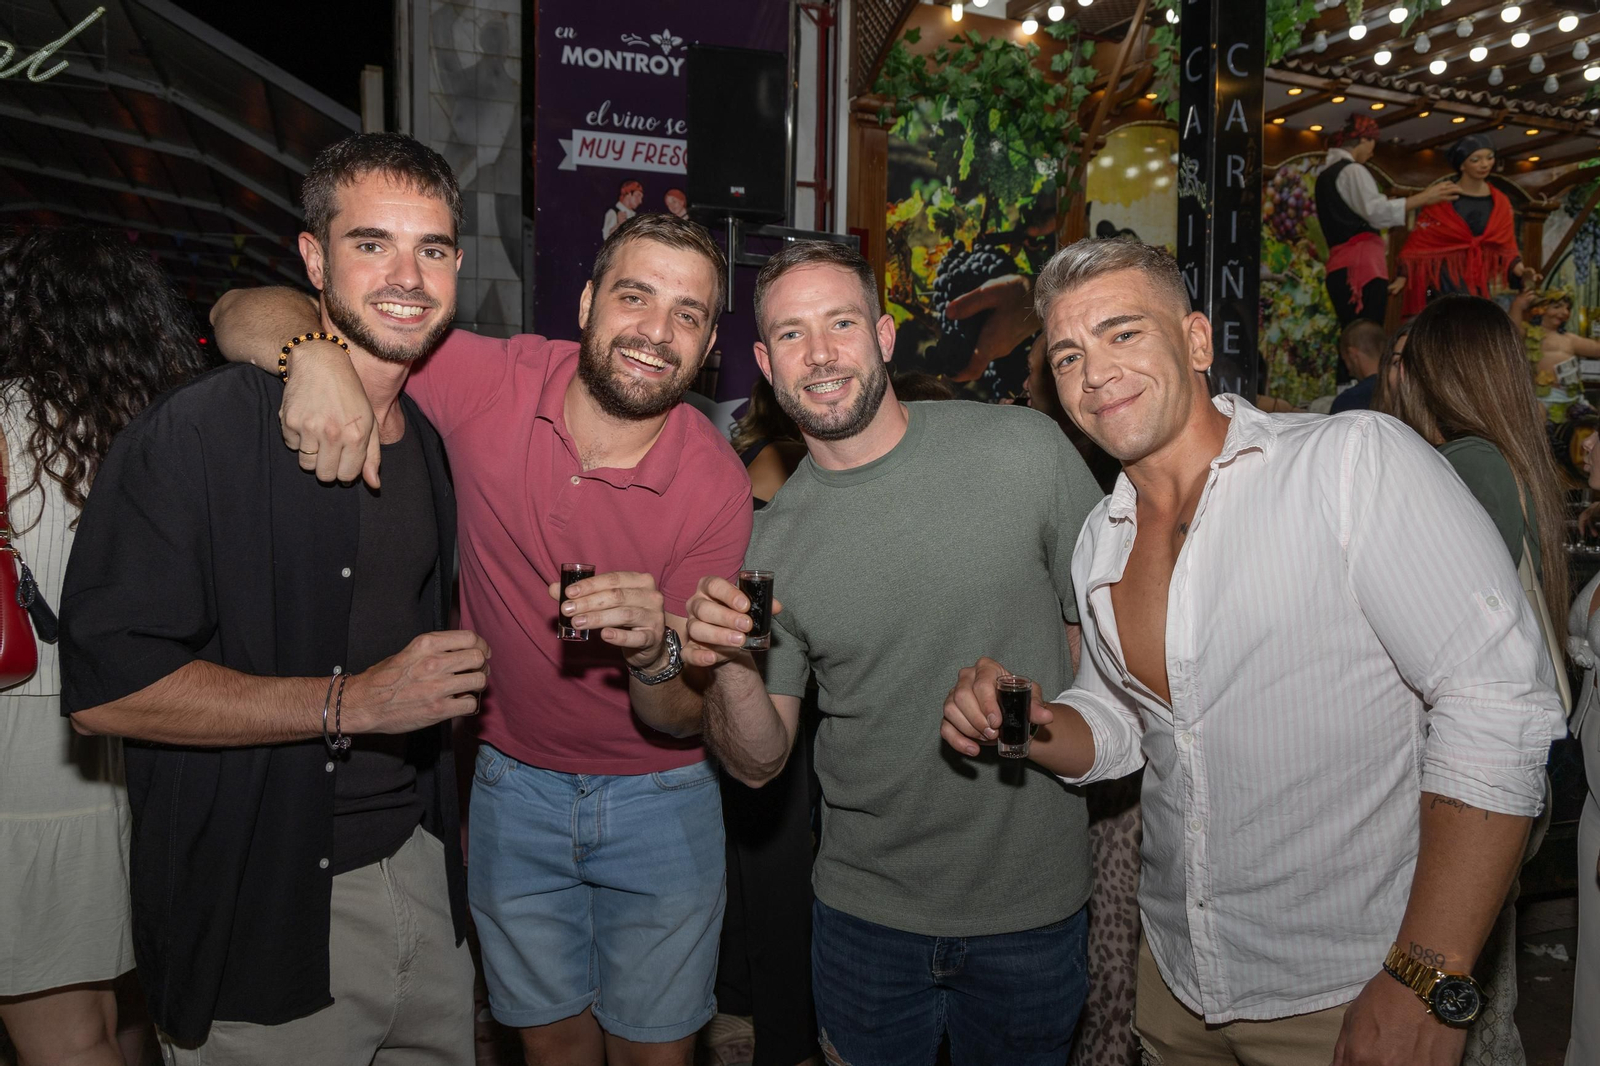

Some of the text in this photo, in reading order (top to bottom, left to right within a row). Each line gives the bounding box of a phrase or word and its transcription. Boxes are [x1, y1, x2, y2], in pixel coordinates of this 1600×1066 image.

[554, 26, 577, 39] en
[561, 45, 685, 77] MONTROY
[586, 100, 688, 135] el vino se
[578, 136, 626, 162] MUY
[1408, 941, 1446, 968] 1989
